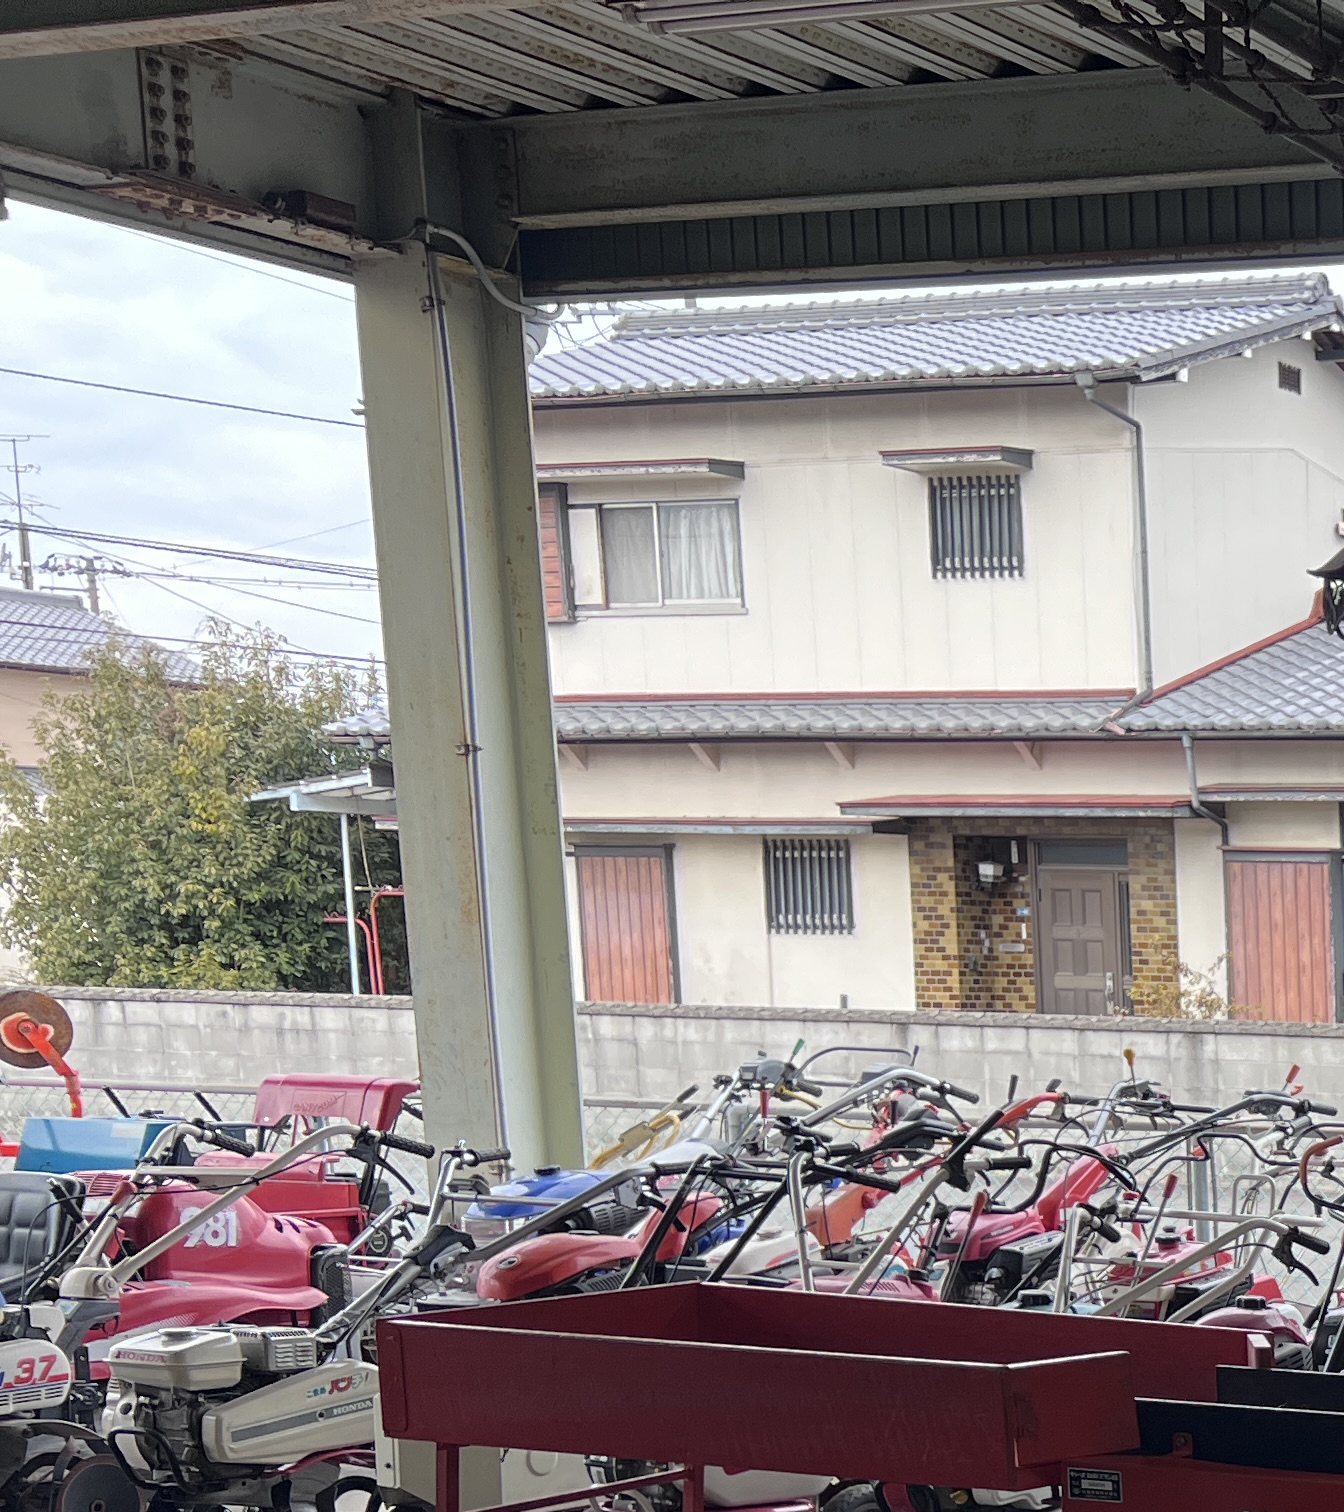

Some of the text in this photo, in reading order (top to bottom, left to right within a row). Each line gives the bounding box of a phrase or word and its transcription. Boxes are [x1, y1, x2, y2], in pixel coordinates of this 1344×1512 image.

[180, 1206, 236, 1247] 981
[115, 1351, 168, 1363] HONDA
[333, 1401, 373, 1416] HONDA
